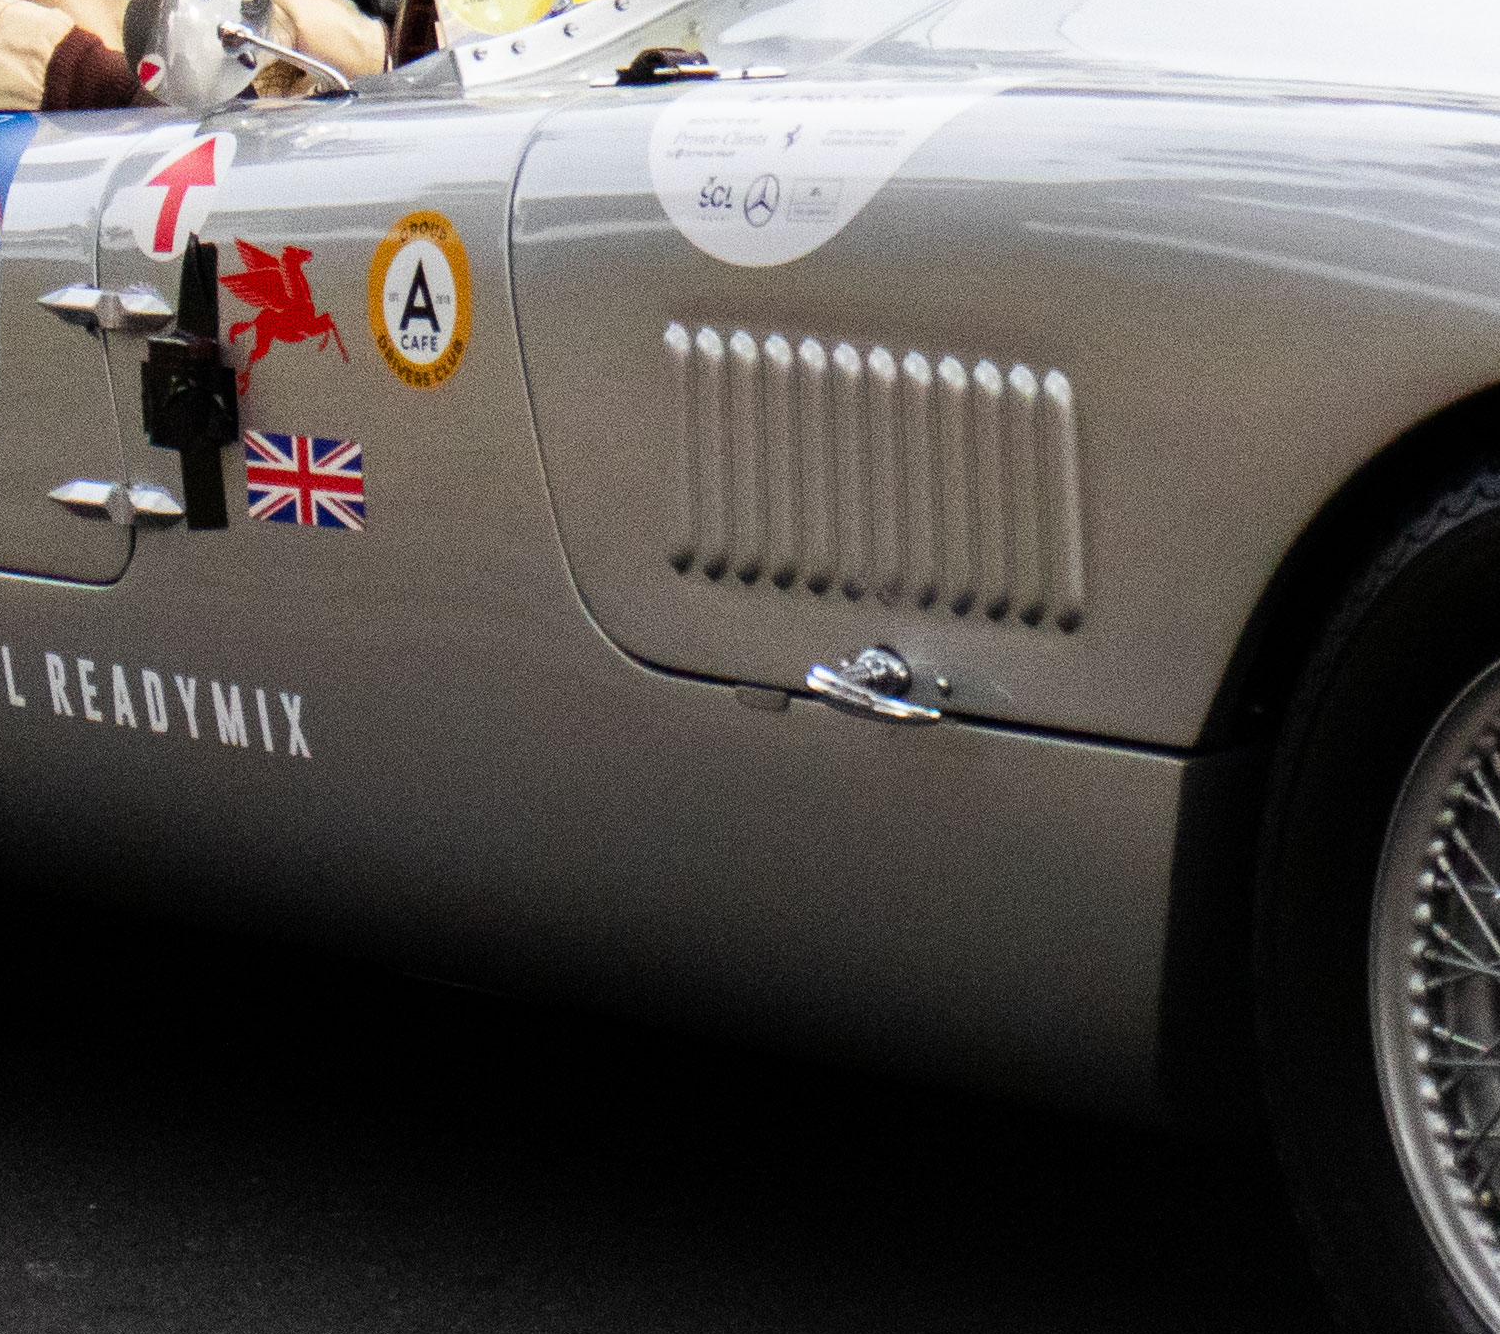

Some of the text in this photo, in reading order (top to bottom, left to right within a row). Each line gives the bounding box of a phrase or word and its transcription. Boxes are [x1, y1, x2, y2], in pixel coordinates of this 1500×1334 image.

[399, 258, 442, 333] A
[378, 334, 464, 387] DRIVERS CLUB
[400, 334, 439, 353] CAFE
[45, 650, 312, 759] READYMIX
